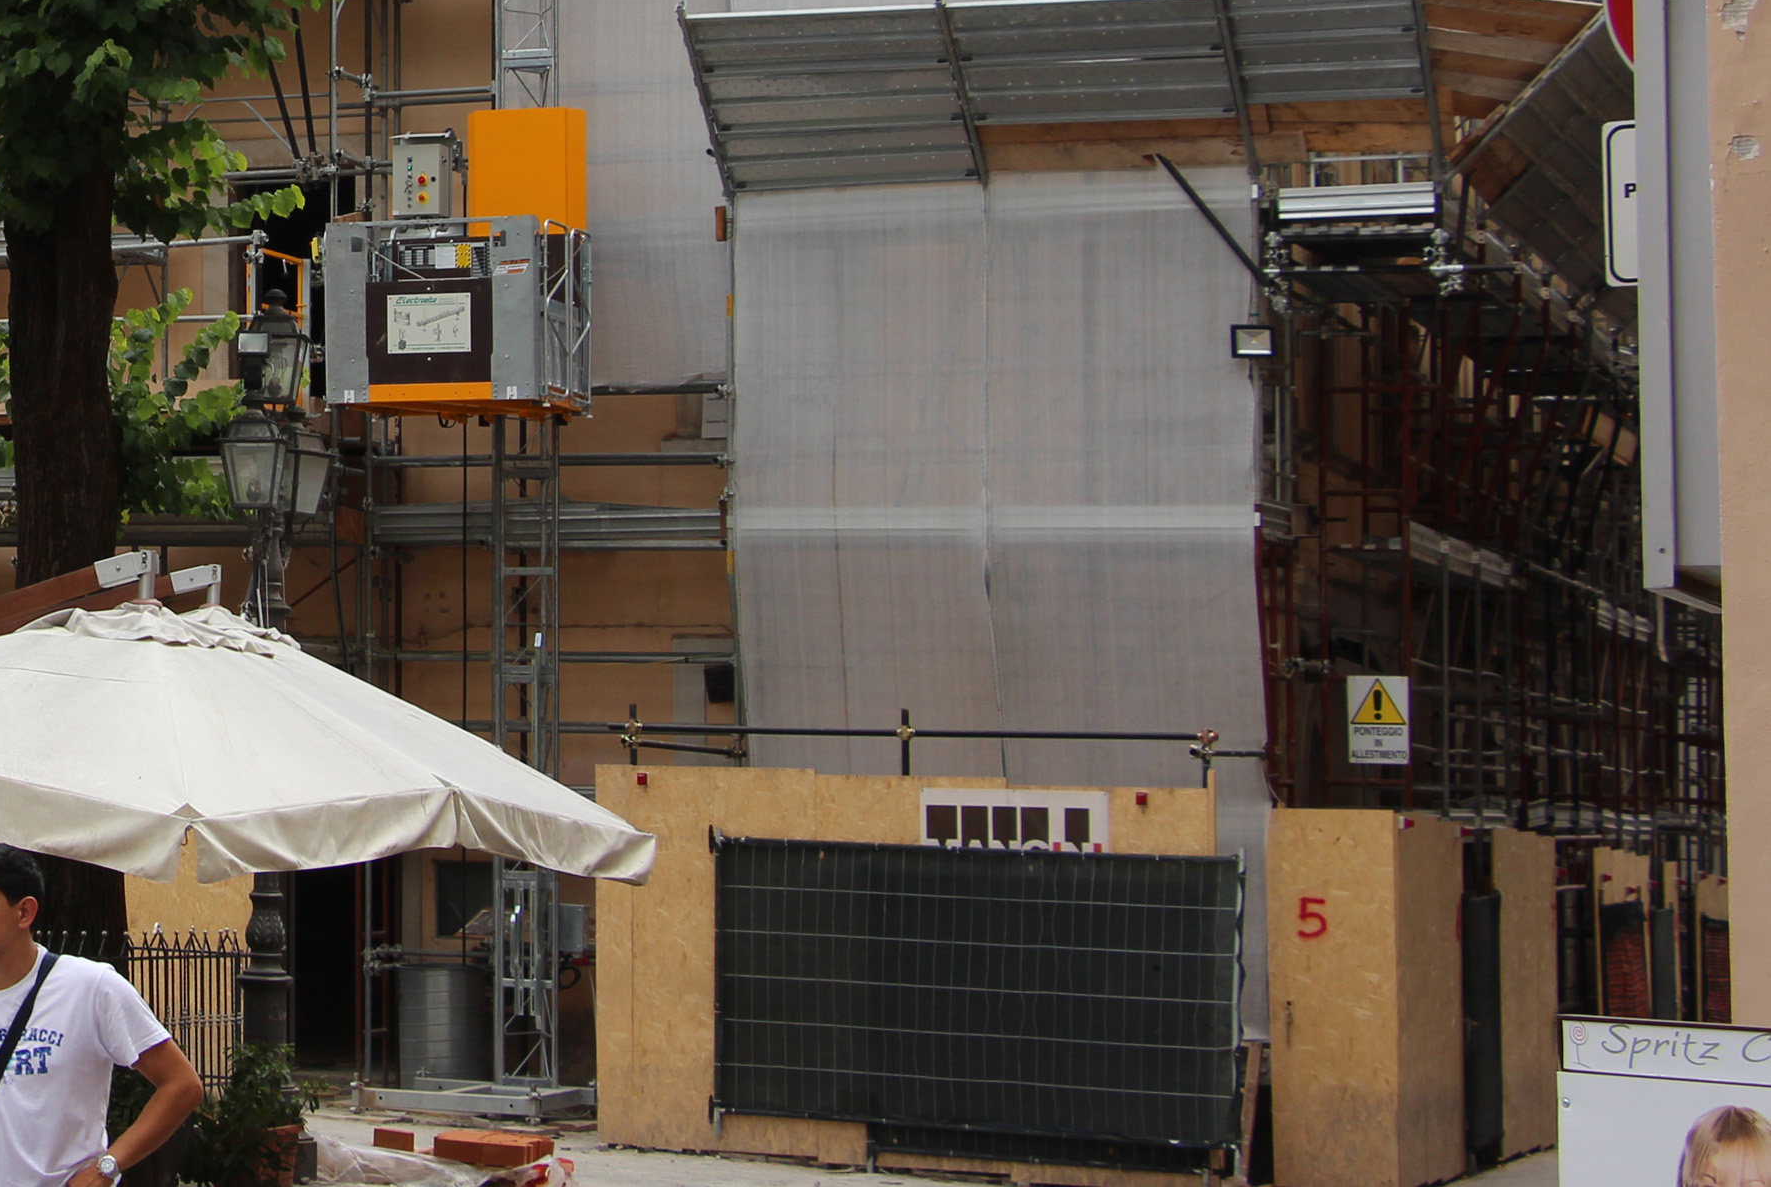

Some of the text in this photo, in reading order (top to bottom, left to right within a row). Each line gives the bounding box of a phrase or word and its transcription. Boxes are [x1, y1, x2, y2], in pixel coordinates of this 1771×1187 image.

[1354, 726, 1404, 736] PONTEGGIO
[1373, 738, 1383, 747] IN
[1352, 749, 1407, 759] ALLESTIMENTO
[1297, 896, 1327, 939] 5
[1601, 1024, 1721, 1069] Spritz
